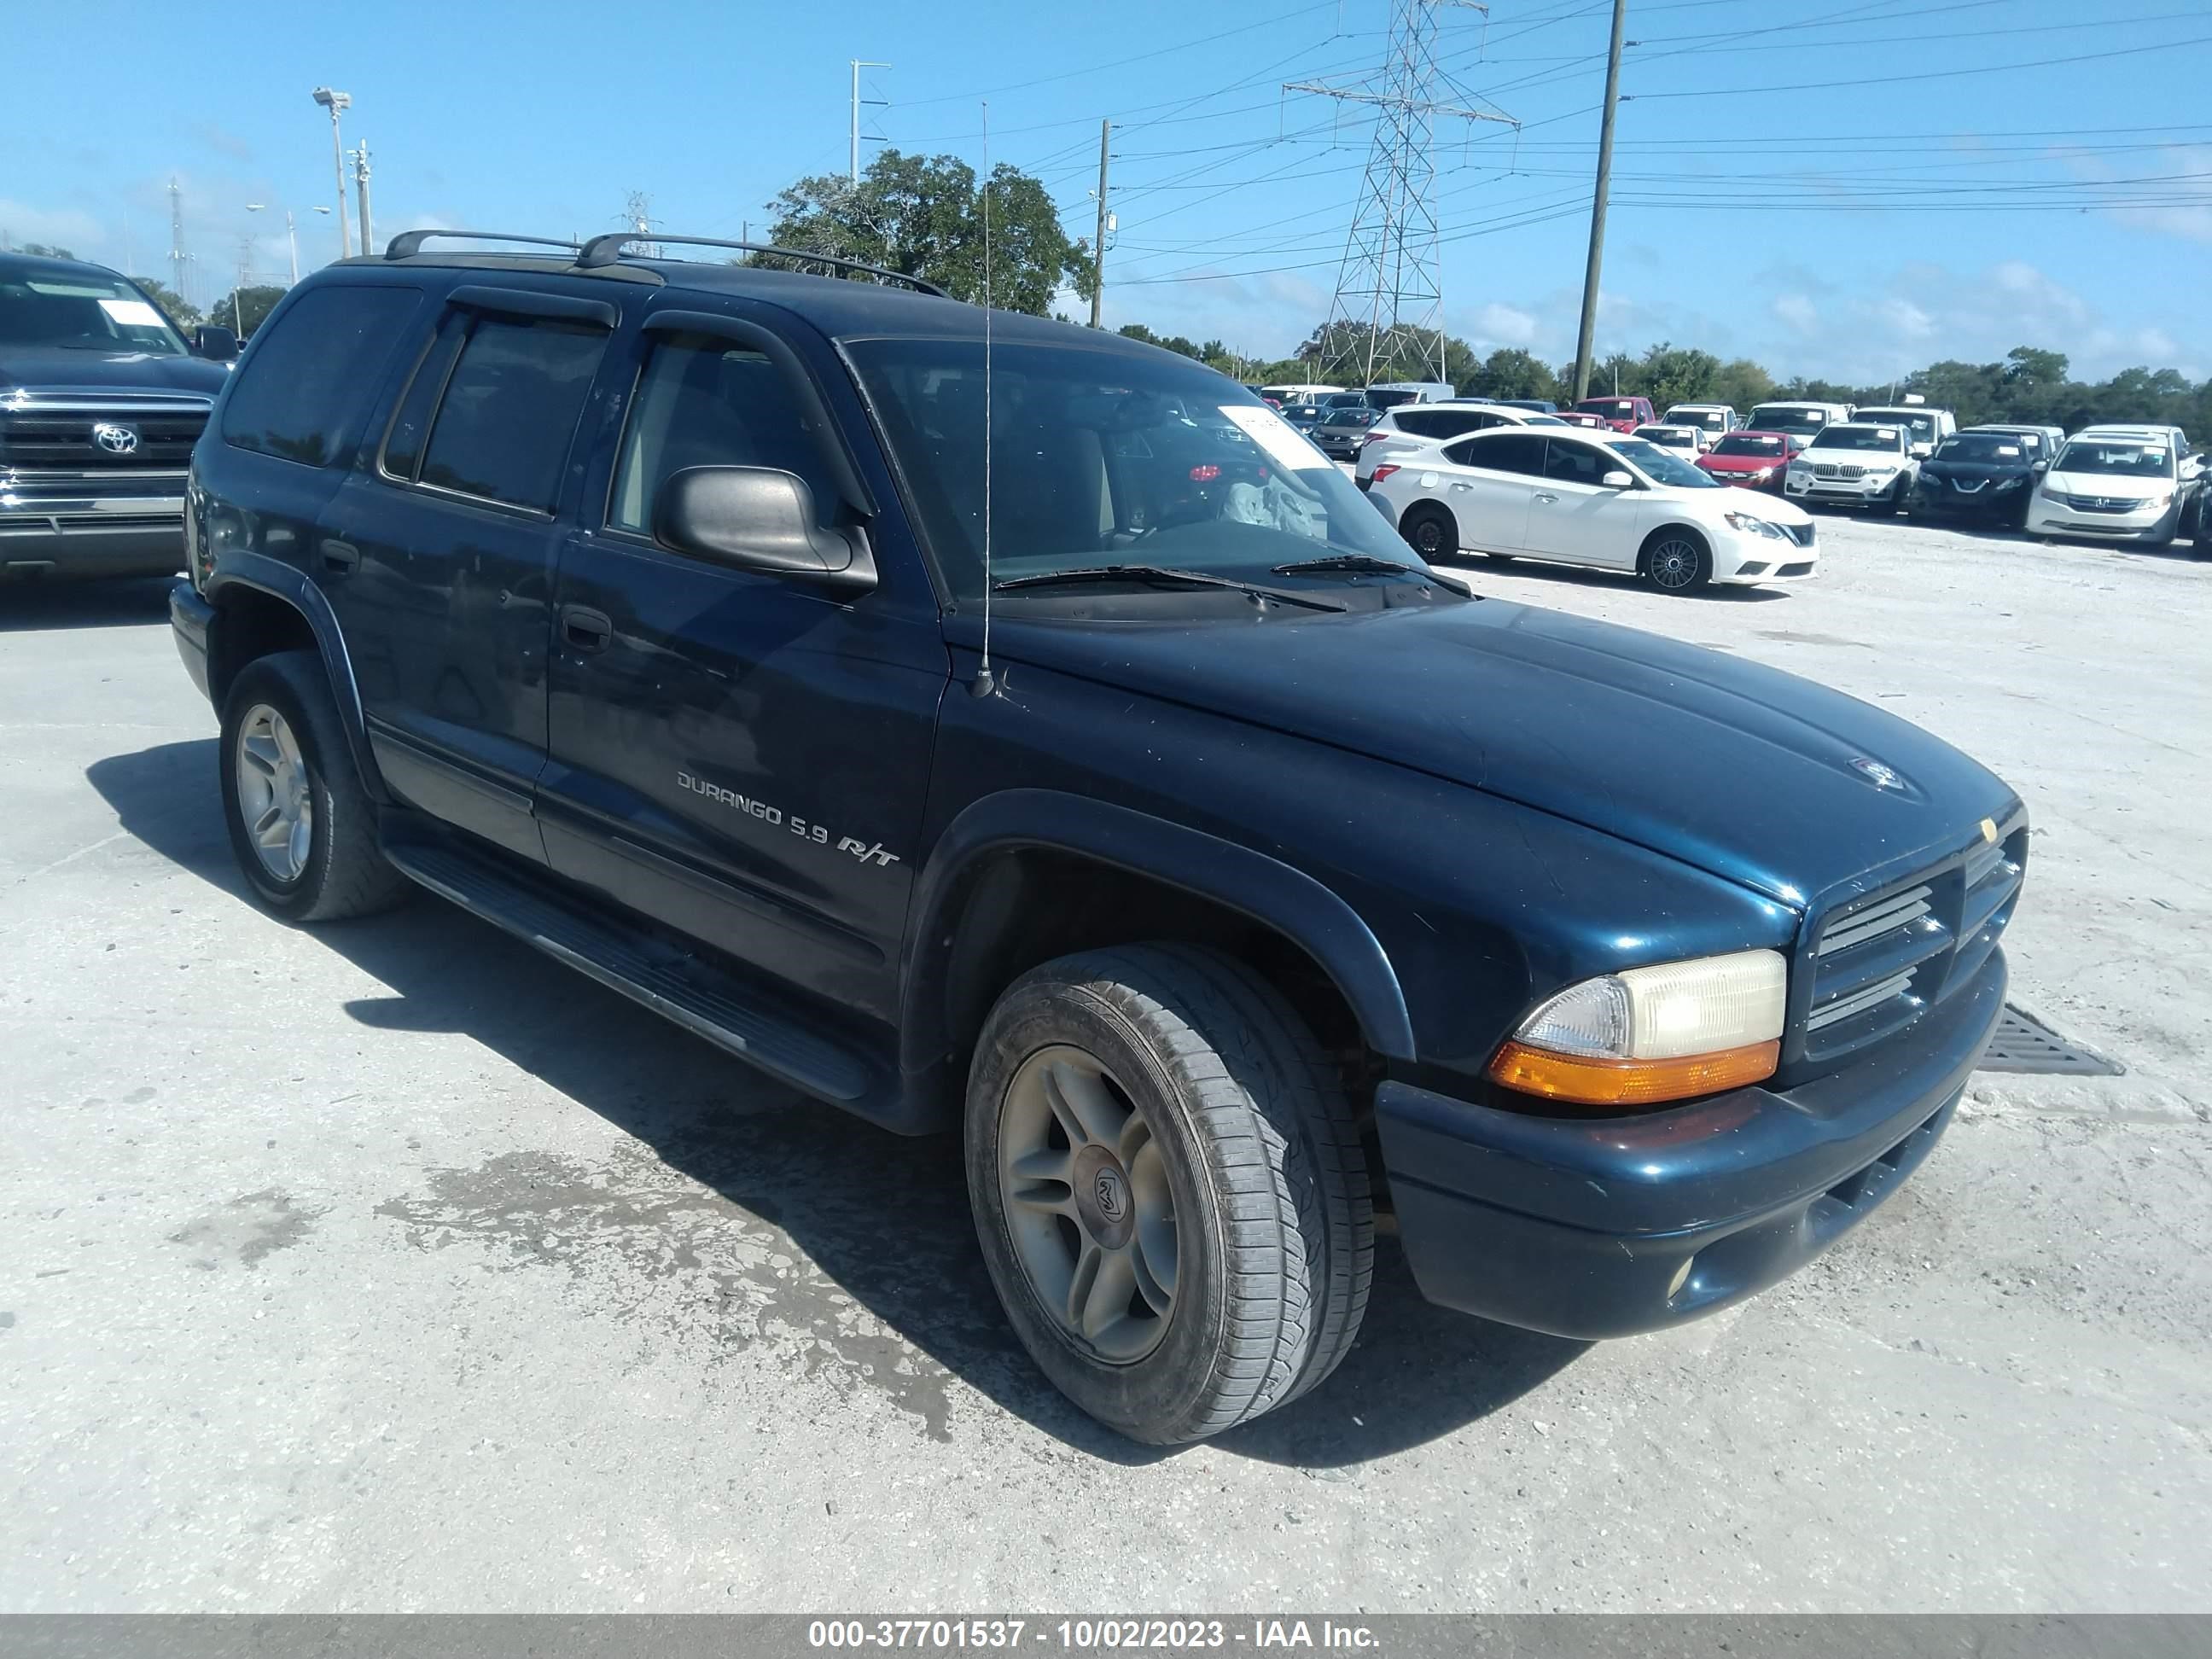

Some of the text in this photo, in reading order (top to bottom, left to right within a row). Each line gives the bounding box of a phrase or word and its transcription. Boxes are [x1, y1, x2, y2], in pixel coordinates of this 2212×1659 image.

[677, 771, 899, 867] DURANGO 5.9 R/T
